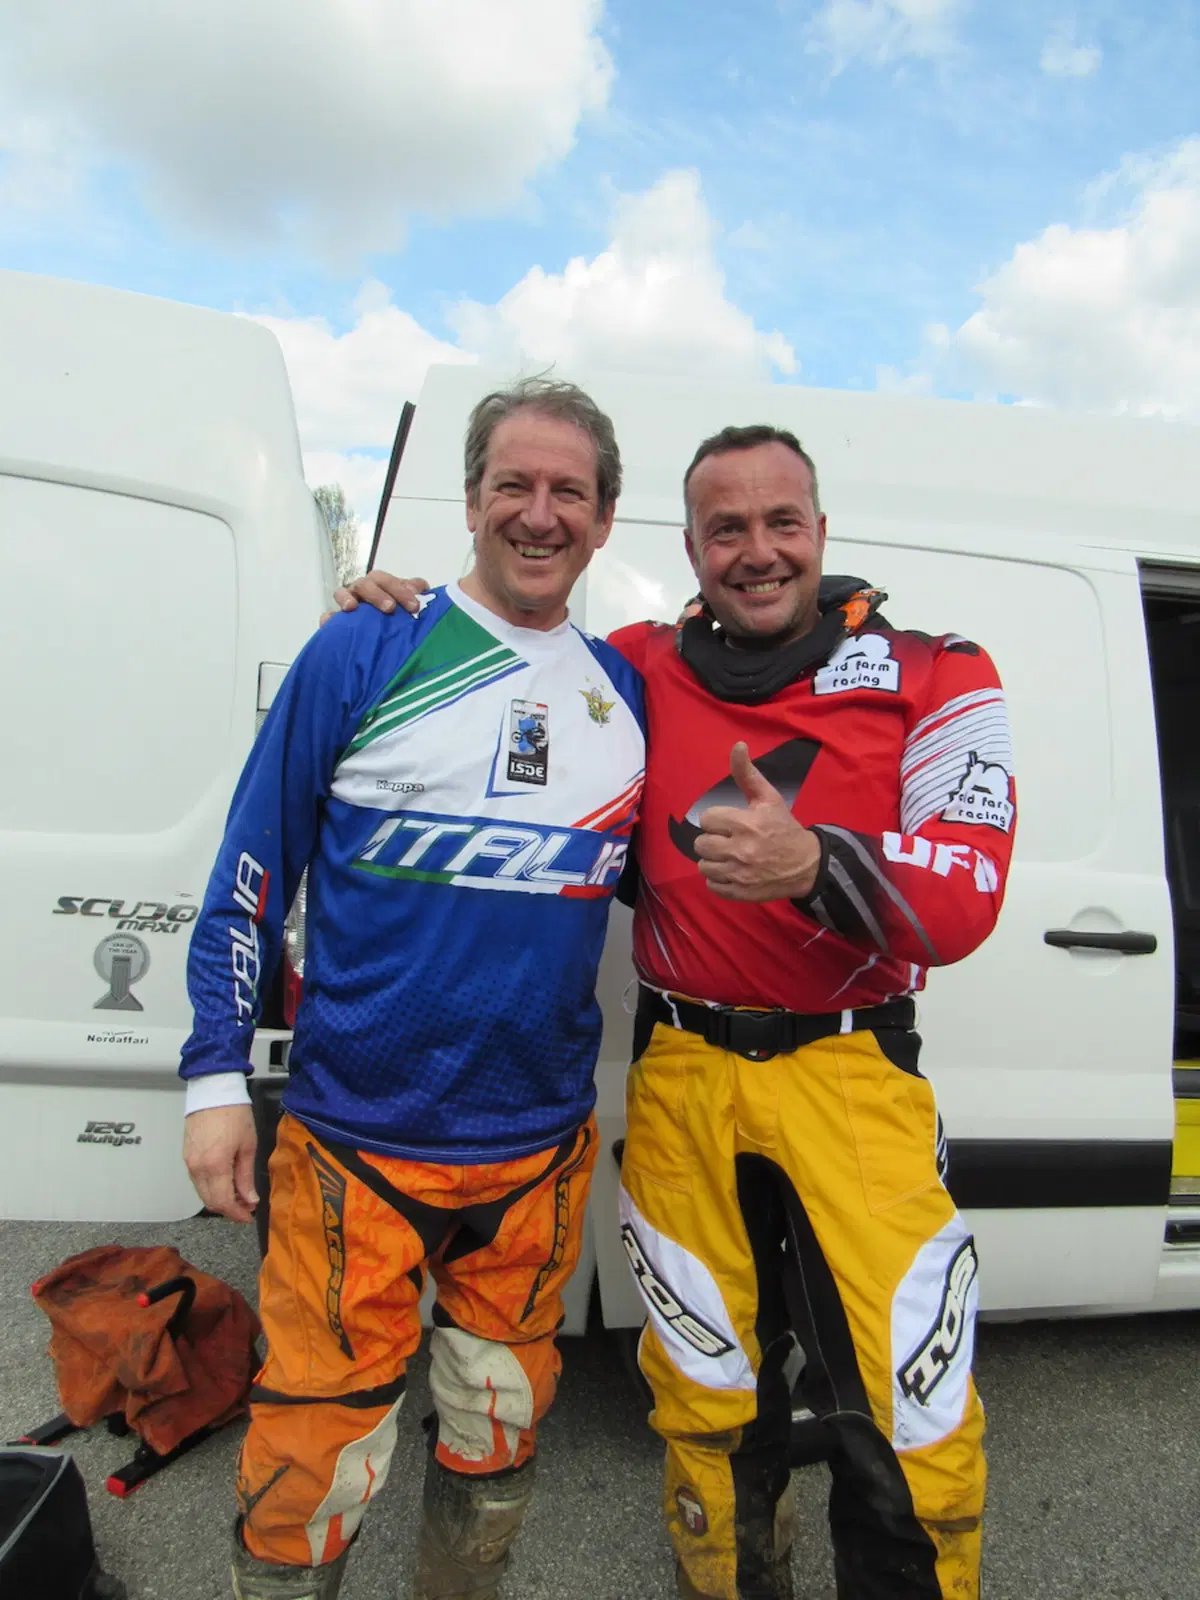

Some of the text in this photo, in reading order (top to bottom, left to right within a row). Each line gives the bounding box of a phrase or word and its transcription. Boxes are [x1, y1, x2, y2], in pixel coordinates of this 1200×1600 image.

[827, 660, 890, 673] ld farm
[833, 673, 880, 687] racing
[510, 761, 544, 778] ISDE
[376, 779, 424, 793] Kappa
[958, 808, 1006, 827] racing
[52, 895, 199, 924] SCUDO
[229, 851, 265, 1027] TALIA
[87, 1034, 149, 1045] Nordaffari
[84, 1120, 136, 1134] 120
